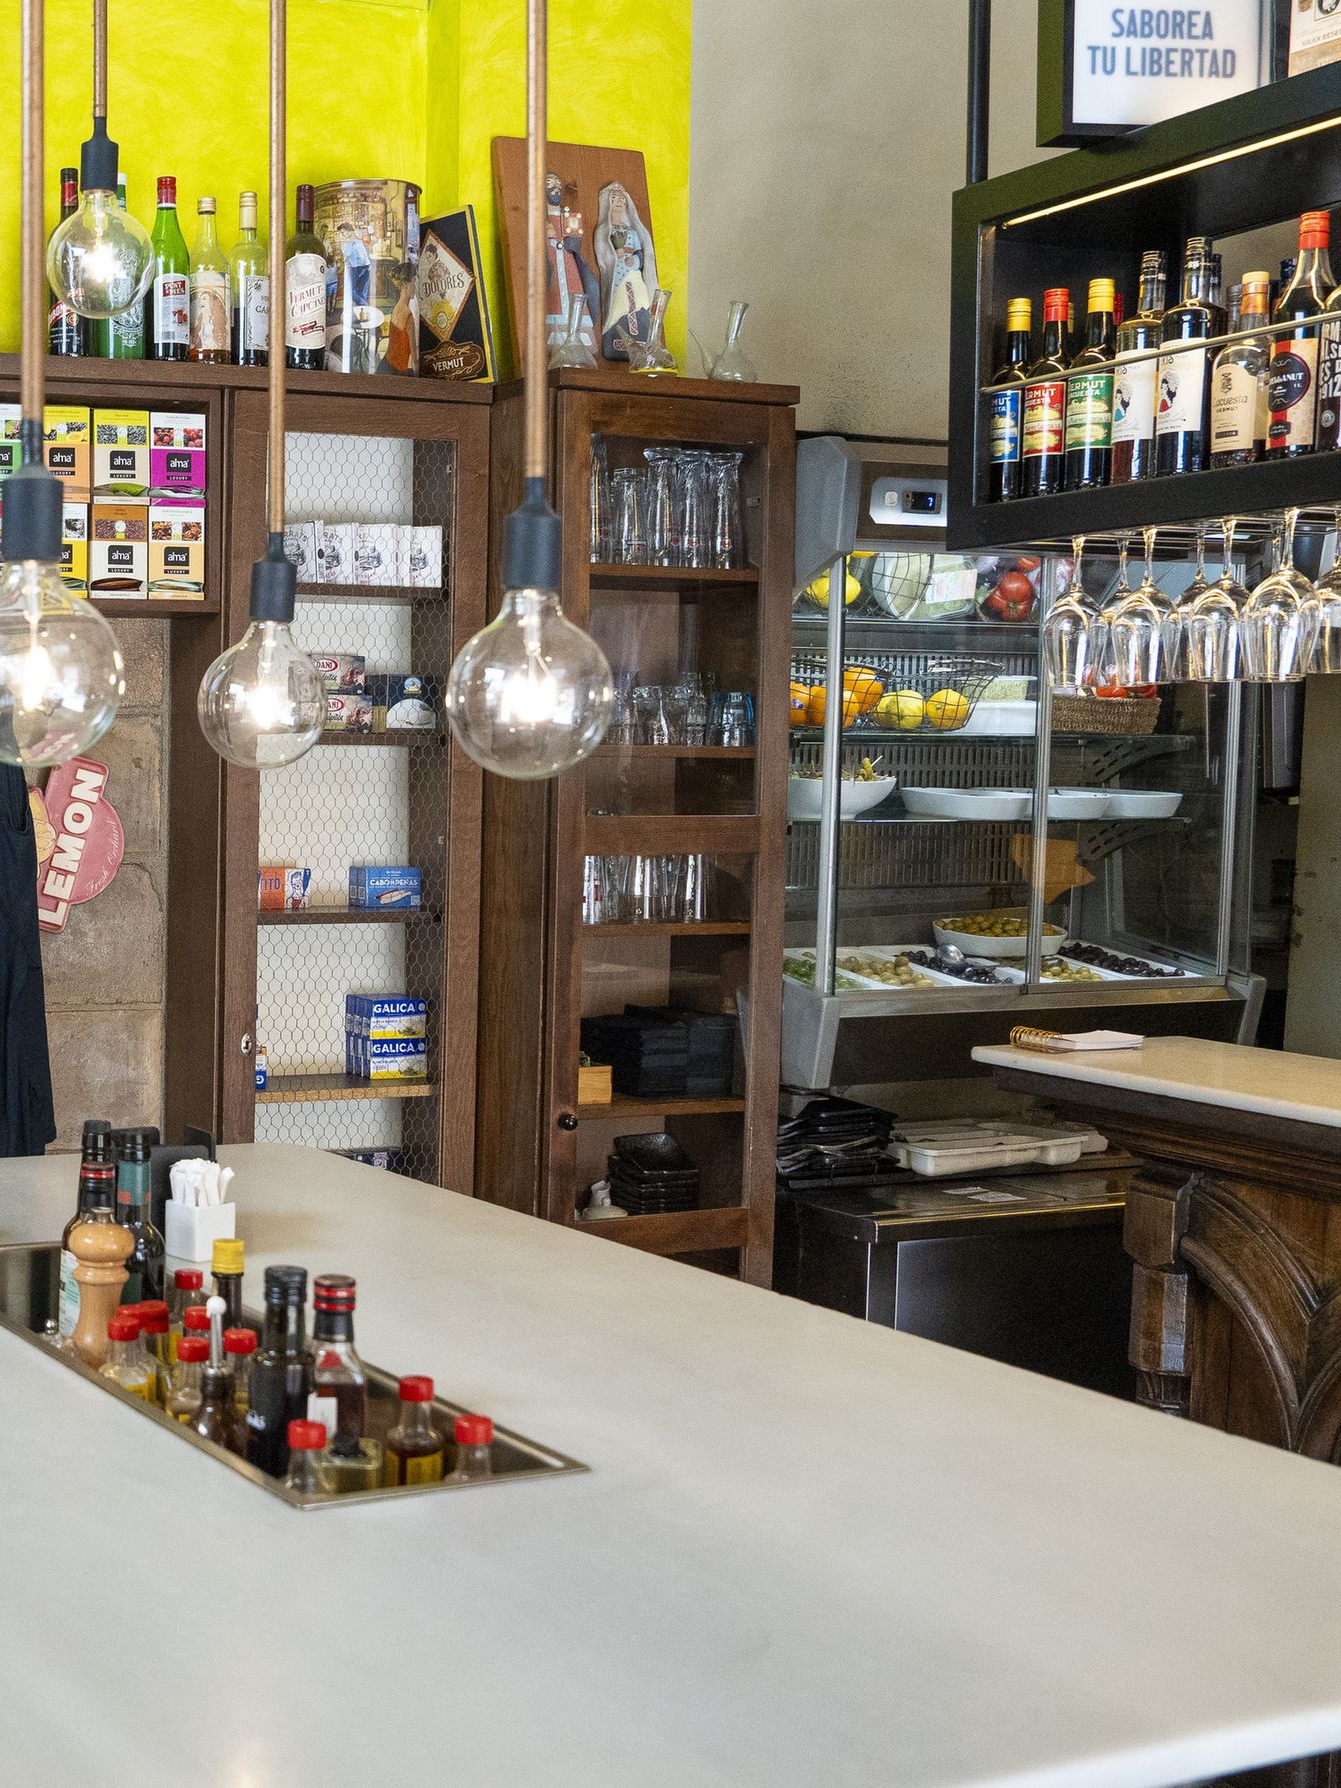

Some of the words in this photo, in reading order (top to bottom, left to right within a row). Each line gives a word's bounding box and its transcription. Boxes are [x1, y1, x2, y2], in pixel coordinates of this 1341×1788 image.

[1111, 8, 1215, 40] SABOREA
[1087, 44, 1117, 76] TU
[1125, 46, 1237, 80] LIBERTAD
[423, 272, 465, 298] DOLORES
[432, 357, 465, 373] VERMUT
[52, 452, 73, 463] alma
[113, 456, 133, 466] alma
[169, 458, 189, 468] alma
[927, 496, 933, 507] 7
[111, 550, 131, 561] alma
[167, 552, 187, 562] alma
[316, 661, 333, 670] DANI
[327, 701, 340, 709] ANI
[37, 768, 105, 926] LEMON
[369, 878, 391, 886] CABO
[373, 1002, 415, 1014] GALICA
[373, 1042, 415, 1054] GALICA
